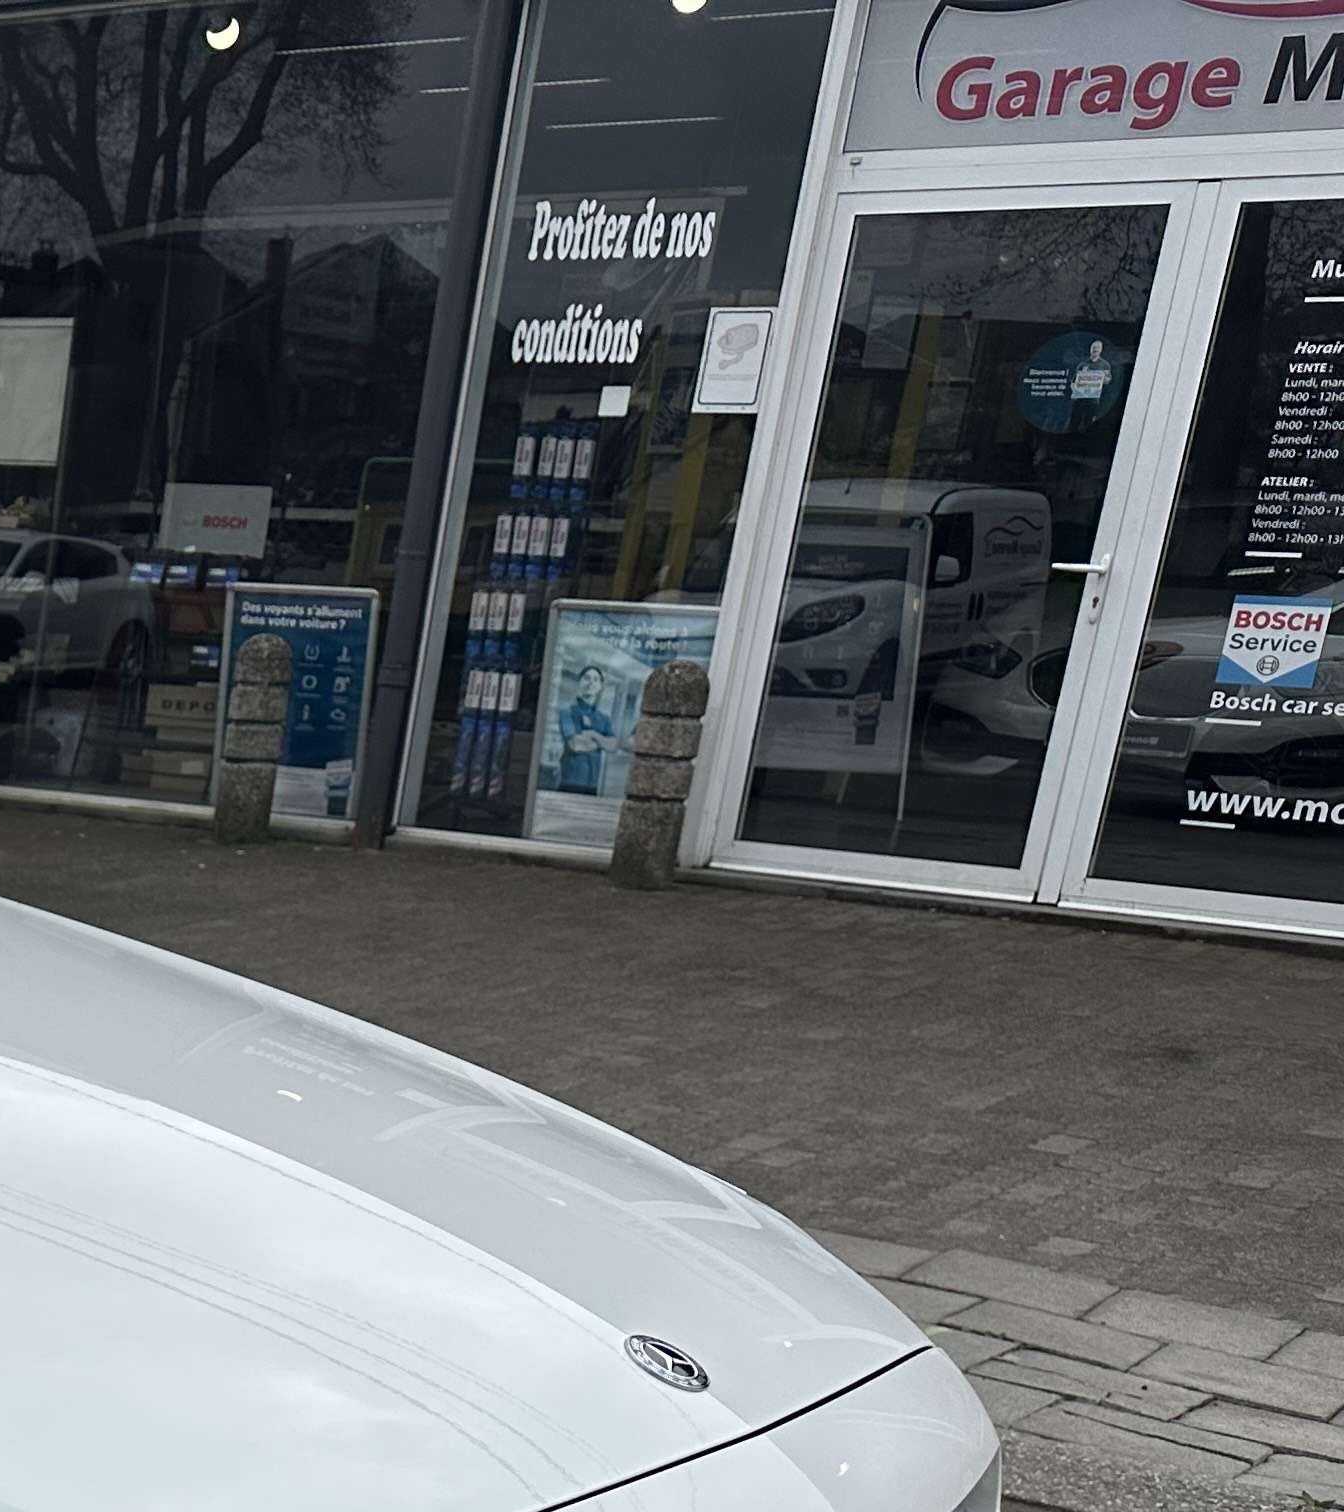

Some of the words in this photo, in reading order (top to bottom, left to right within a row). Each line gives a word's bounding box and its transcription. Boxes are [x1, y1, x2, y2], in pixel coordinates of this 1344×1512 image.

[936, 56, 1241, 131] Garage
[528, 198, 631, 261] Profitez
[632, 197, 665, 259] de
[665, 211, 716, 258] nos
[512, 303, 643, 364] conditions
[1289, 362, 1328, 374] VENTE
[1274, 420, 1303, 431] 8h00
[1271, 434, 1313, 445] Samedi
[1267, 448, 1297, 459] 8h00
[1305, 449, 1340, 459] 12h00
[1260, 476, 1309, 488] ATELIER
[1254, 504, 1283, 515] 8h00
[1292, 505, 1326, 516] 12h00
[202, 514, 249, 530] BOSCH
[1252, 518, 1301, 530] Vendredi
[1247, 532, 1276, 543] 8h00
[1284, 532, 1319, 544] 12h00
[241, 601, 262, 613] Des
[264, 603, 305, 618] voyants
[307, 604, 363, 619] s'allument
[240, 613, 266, 626] dans
[268, 616, 297, 628] votre
[299, 618, 338, 630] voiture
[1233, 610, 1325, 633] BOSCH
[1228, 633, 1318, 654] Service
[1209, 690, 1277, 712] Bosch
[1281, 699, 1320, 715] car
